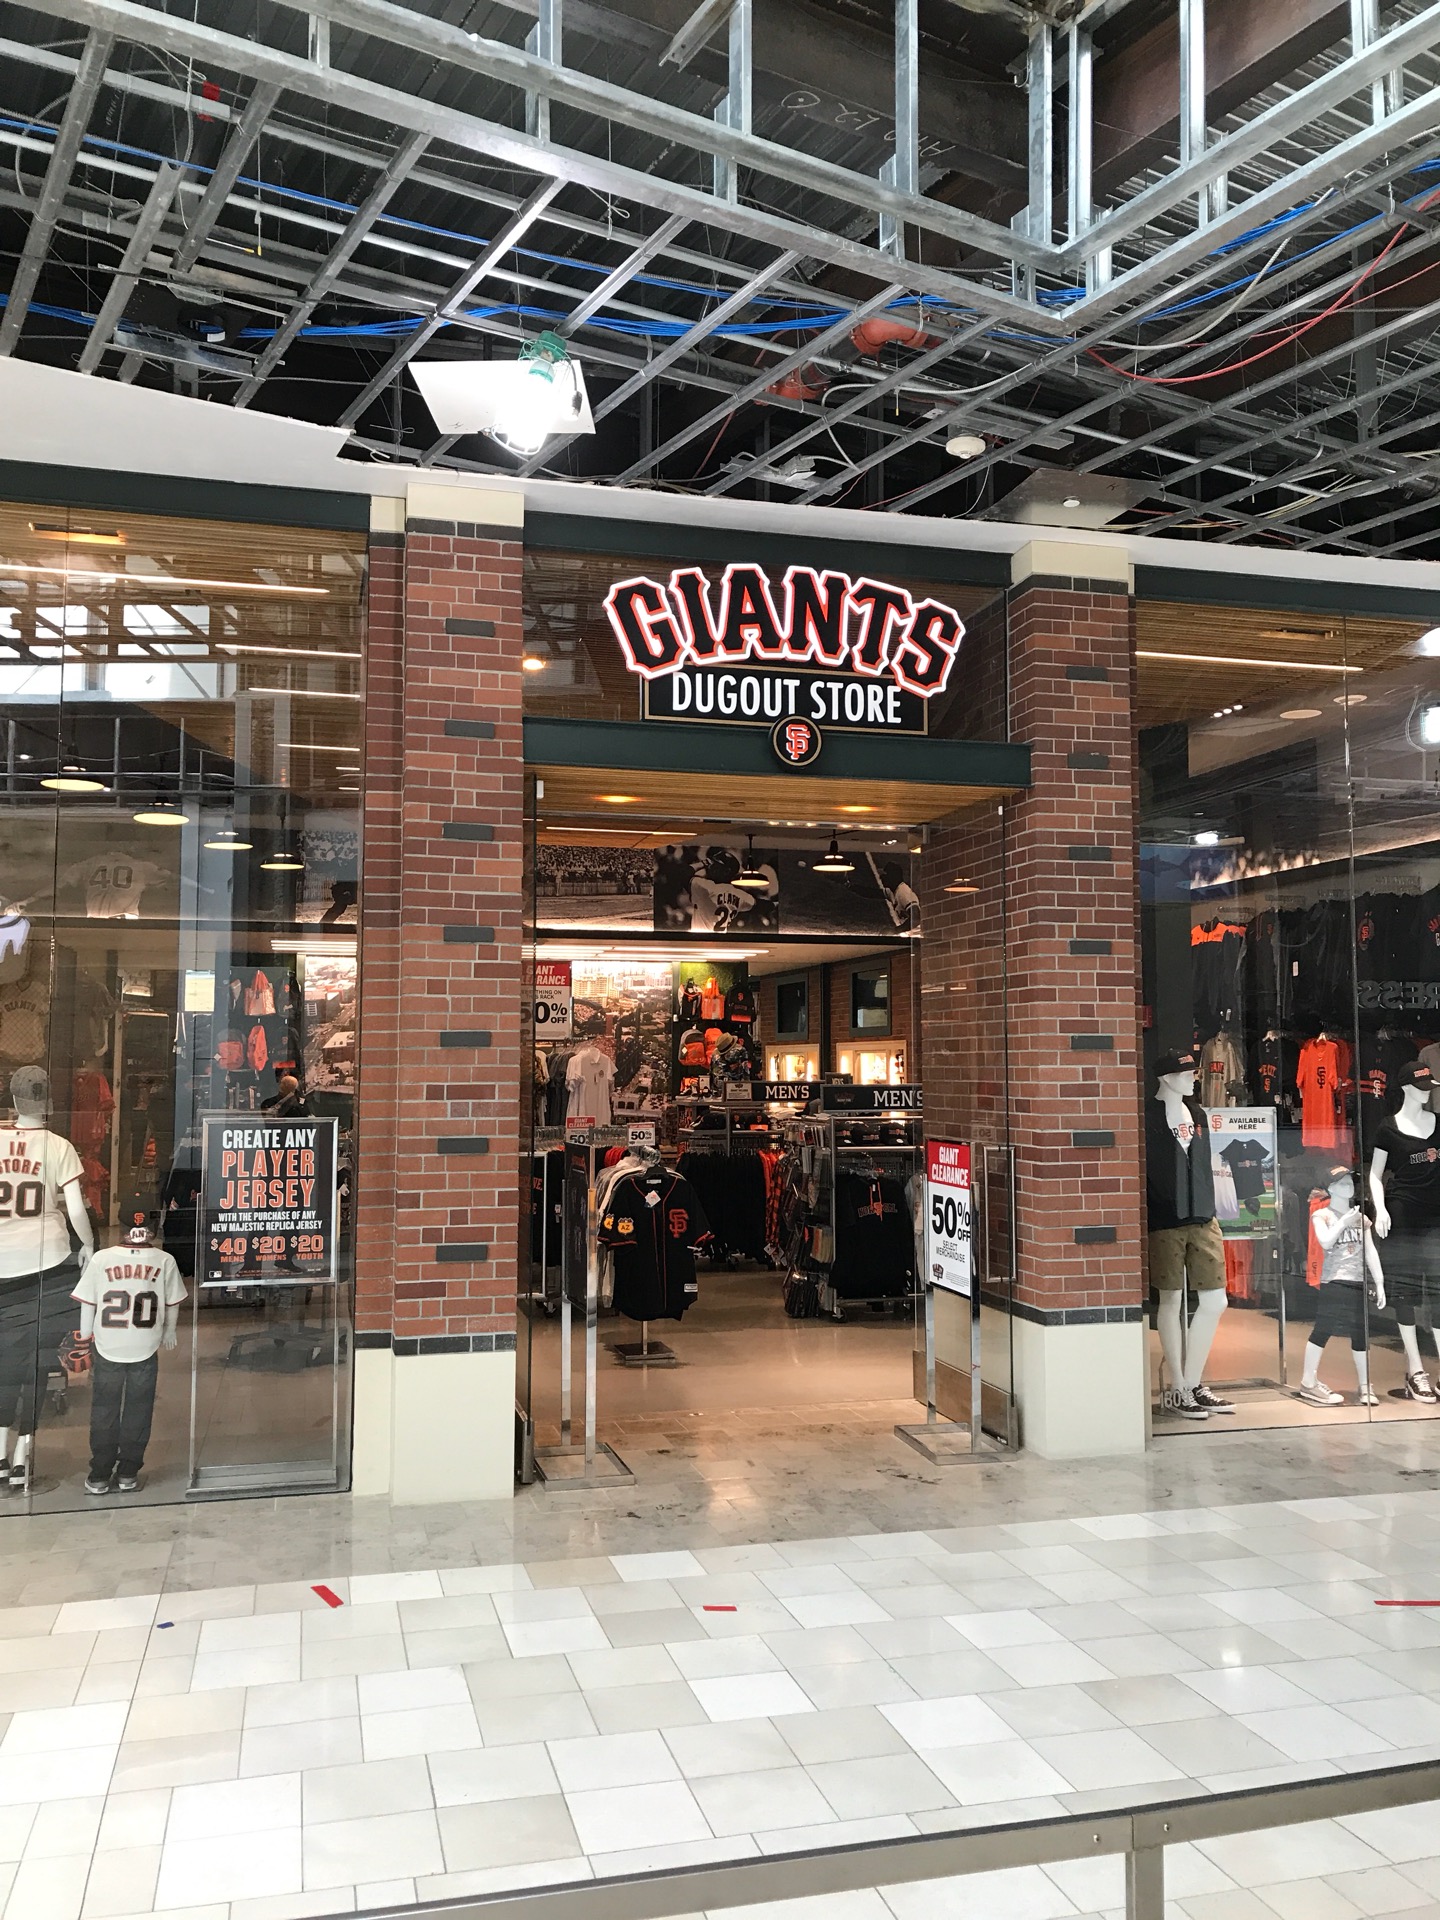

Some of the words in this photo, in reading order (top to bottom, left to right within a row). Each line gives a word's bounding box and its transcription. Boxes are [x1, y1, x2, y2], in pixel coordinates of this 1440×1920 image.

[602, 563, 966, 698] GIANTS
[672, 671, 800, 717] DUGOUT
[810, 680, 902, 723] STORE
[89, 865, 133, 889] 40
[765, 1085, 810, 1099] MEN'S
[222, 1129, 281, 1148] CREATE
[285, 1128, 317, 1148] ANY
[9, 1140, 27, 1157] IN
[939, 1146, 959, 1165] GIANT
[221, 1149, 315, 1178] PLAYER
[931, 1163, 969, 1187] CLEARANCE
[219, 1178, 315, 1209] JERSEY
[211, 1223, 227, 1232] NEW
[229, 1221, 264, 1232] MAJESTIC
[266, 1220, 294, 1231] REPLICA
[296, 1220, 322, 1230] JERSEY
[218, 1212, 237, 1222] WITH
[239, 1212, 252, 1222] THE
[254, 1211, 290, 1221] PURCHASE
[291, 1211, 301, 1220] OF
[301, 1210, 316, 1220] ANY
[669, 1208, 688, 1239] SF
[932, 1194, 971, 1238] 50%
[210, 1237, 247, 1255] $40
[252, 1236, 286, 1254] $20
[290, 1234, 324, 1252] $20
[957, 1228, 971, 1242] OFF
[295, 1252, 324, 1260] YOUTH
[936, 1246, 966, 1264] MERCHANDISE
[942, 1240, 958, 1252] SELECT
[104, 1264, 162, 1283] TODAY!
[101, 1290, 159, 1329] 20
